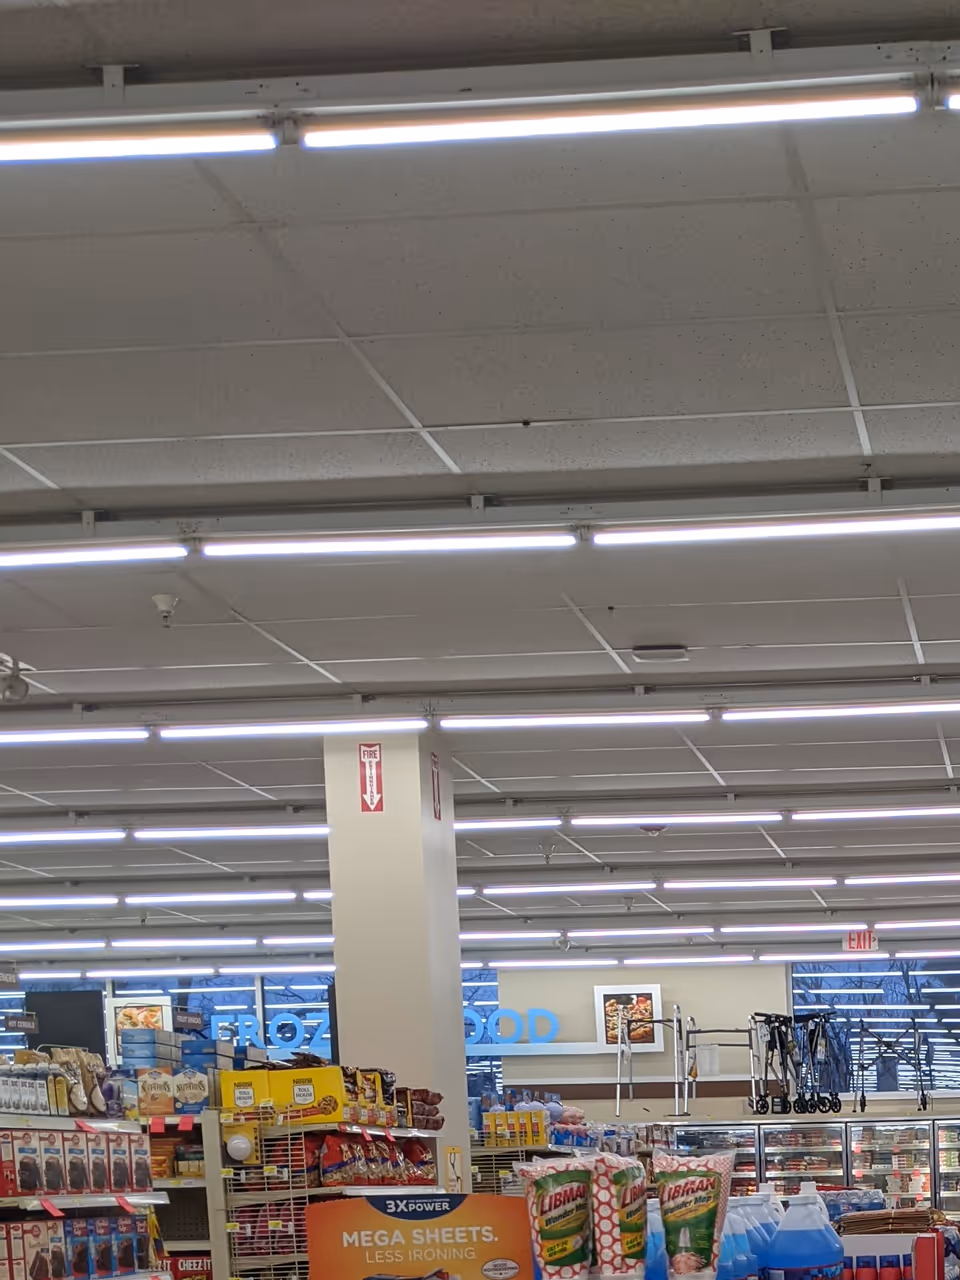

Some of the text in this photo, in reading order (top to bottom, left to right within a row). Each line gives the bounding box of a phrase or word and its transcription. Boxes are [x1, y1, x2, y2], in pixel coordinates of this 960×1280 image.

[363, 750, 378, 759] FIRE
[849, 930, 873, 950] EXIT
[661, 1178, 716, 1204] LIBMAN
[386, 1200, 450, 1213] 3X POWER
[342, 1226, 498, 1247] MEGA SHEETS.
[366, 1247, 477, 1263] LESS IRONING.
